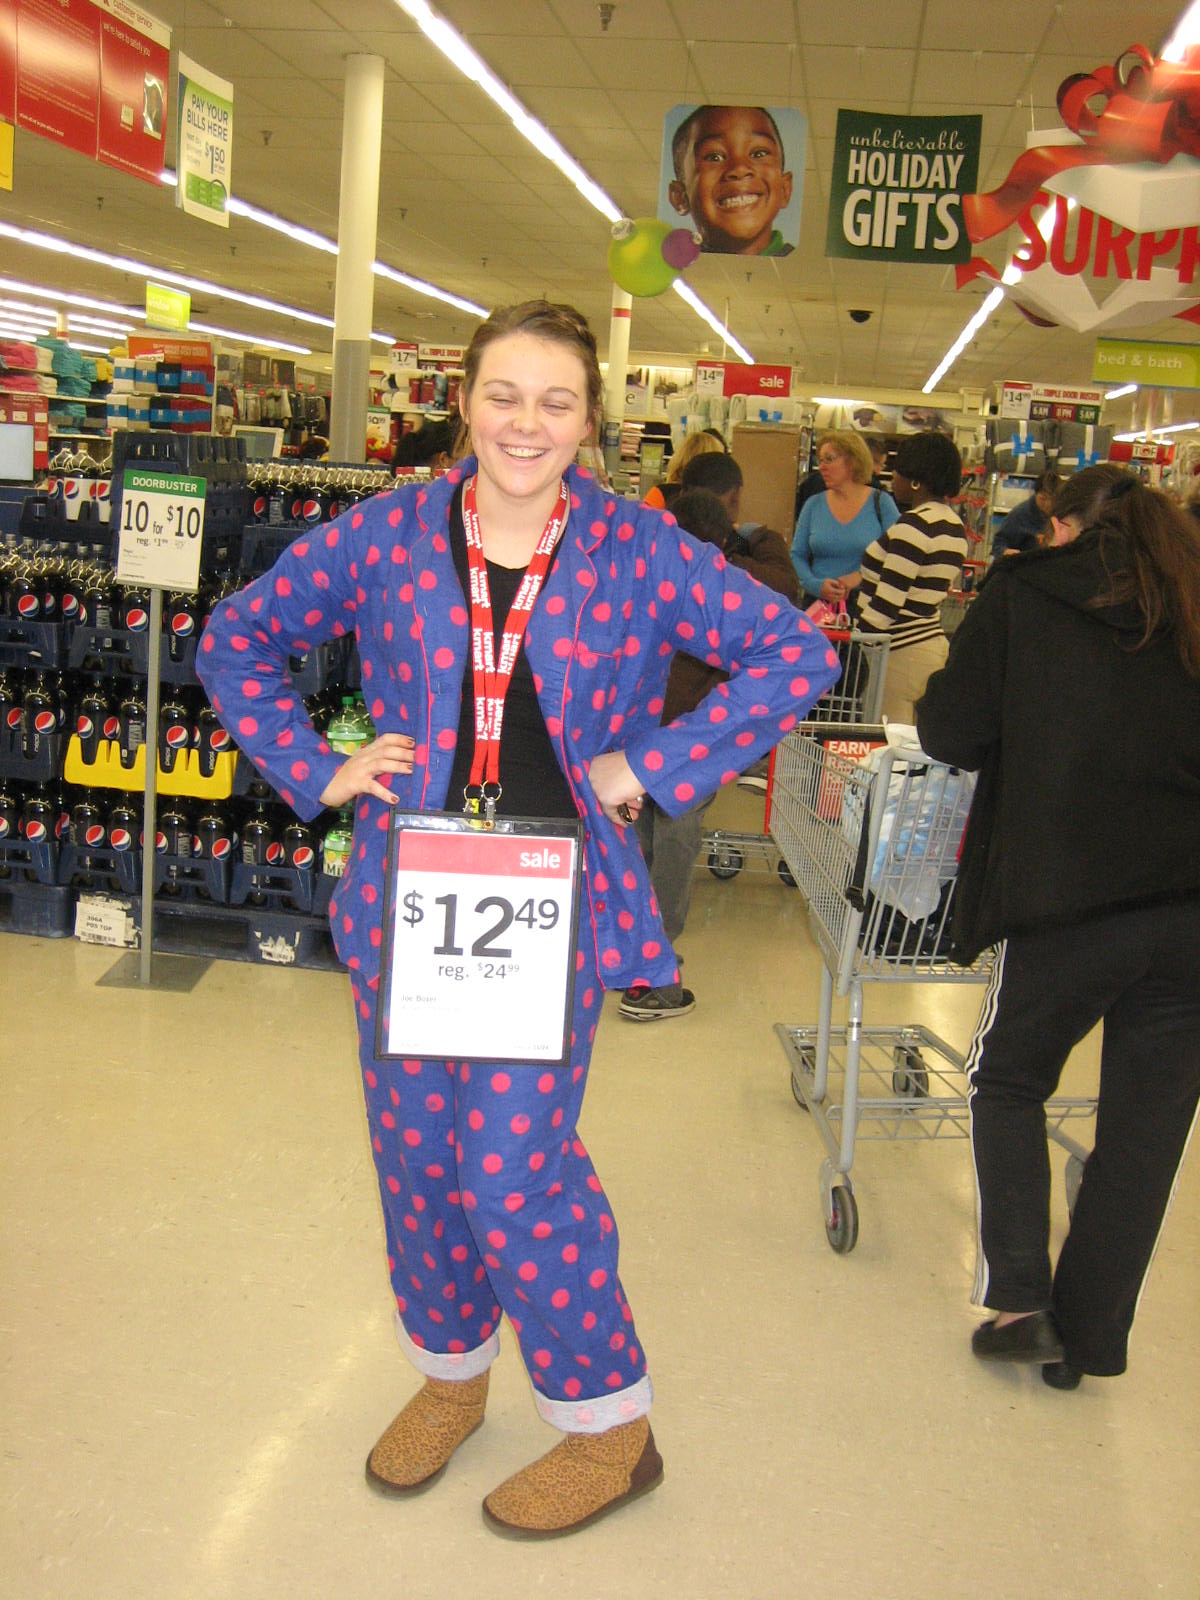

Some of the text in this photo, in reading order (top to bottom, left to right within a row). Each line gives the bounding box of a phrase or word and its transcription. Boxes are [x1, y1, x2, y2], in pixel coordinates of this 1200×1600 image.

[187, 109, 228, 142] BILLS HERE
[192, 94, 228, 125] PAY YOUR
[850, 128, 966, 150] unbelievable
[848, 149, 965, 189] HOLIDAY
[843, 189, 960, 251] GIFTS
[1098, 351, 1183, 369] bed & bath
[759, 375, 785, 389] sale
[132, 476, 198, 493] DOORBUSTER
[123, 499, 201, 538] 10 for $10
[464, 509, 475, 547] kmart
[541, 518, 562, 556] kmart
[136, 537, 151, 547] reg.
[470, 567, 482, 604] kmart
[479, 571, 492, 609] kmart
[511, 574, 534, 611] kmart
[522, 574, 543, 611] kmart
[473, 628, 485, 671] kmart
[483, 631, 496, 673] kmart
[497, 632, 513, 674] kmart
[828, 740, 870, 755] EARN
[520, 848, 561, 869] sale
[438, 963, 470, 981] reg.
